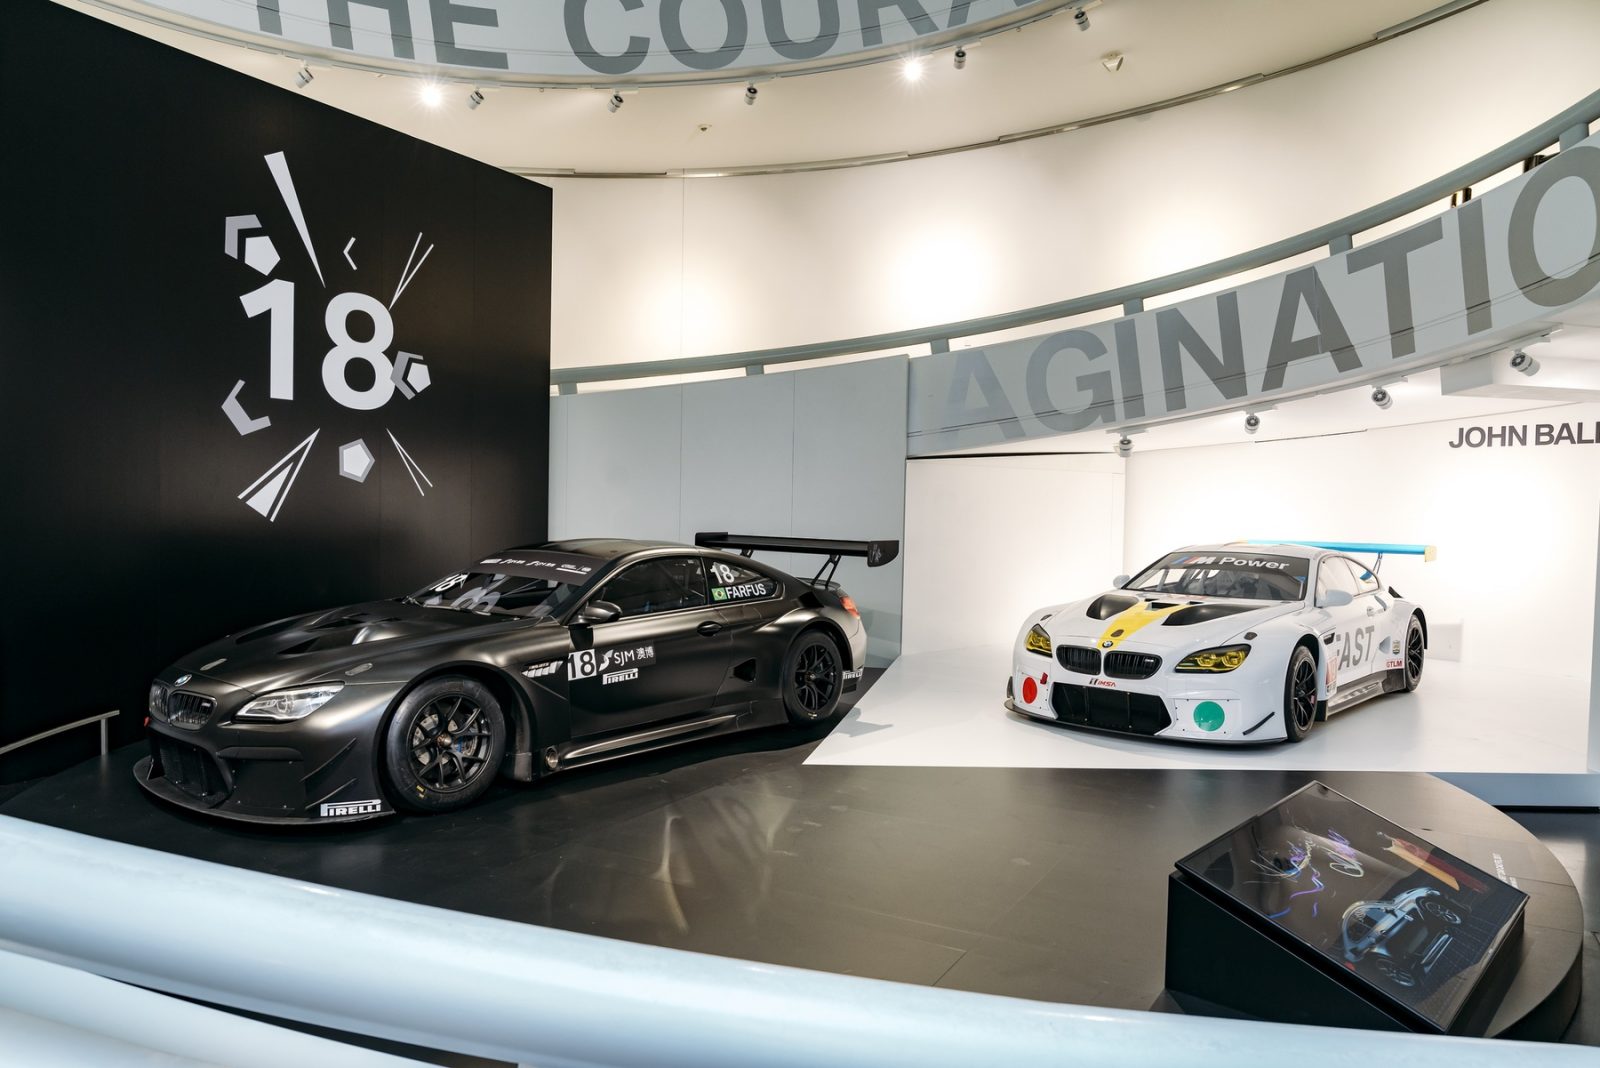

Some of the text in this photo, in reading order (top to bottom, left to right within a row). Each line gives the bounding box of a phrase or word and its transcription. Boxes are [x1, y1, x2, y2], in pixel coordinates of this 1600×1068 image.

[563, 0, 1034, 74] COU
[239, 278, 396, 411] 18
[1449, 421, 1600, 448] JOHN BAL
[1220, 557, 1290, 570] Power
[709, 562, 735, 584] 18
[725, 583, 766, 599] FARFUS
[567, 651, 595, 679] 18
[614, 650, 634, 666] SJM
[1386, 660, 1403, 668] GTLM
[602, 668, 639, 685] PIRELLI
[320, 799, 382, 817] PIRELLI
